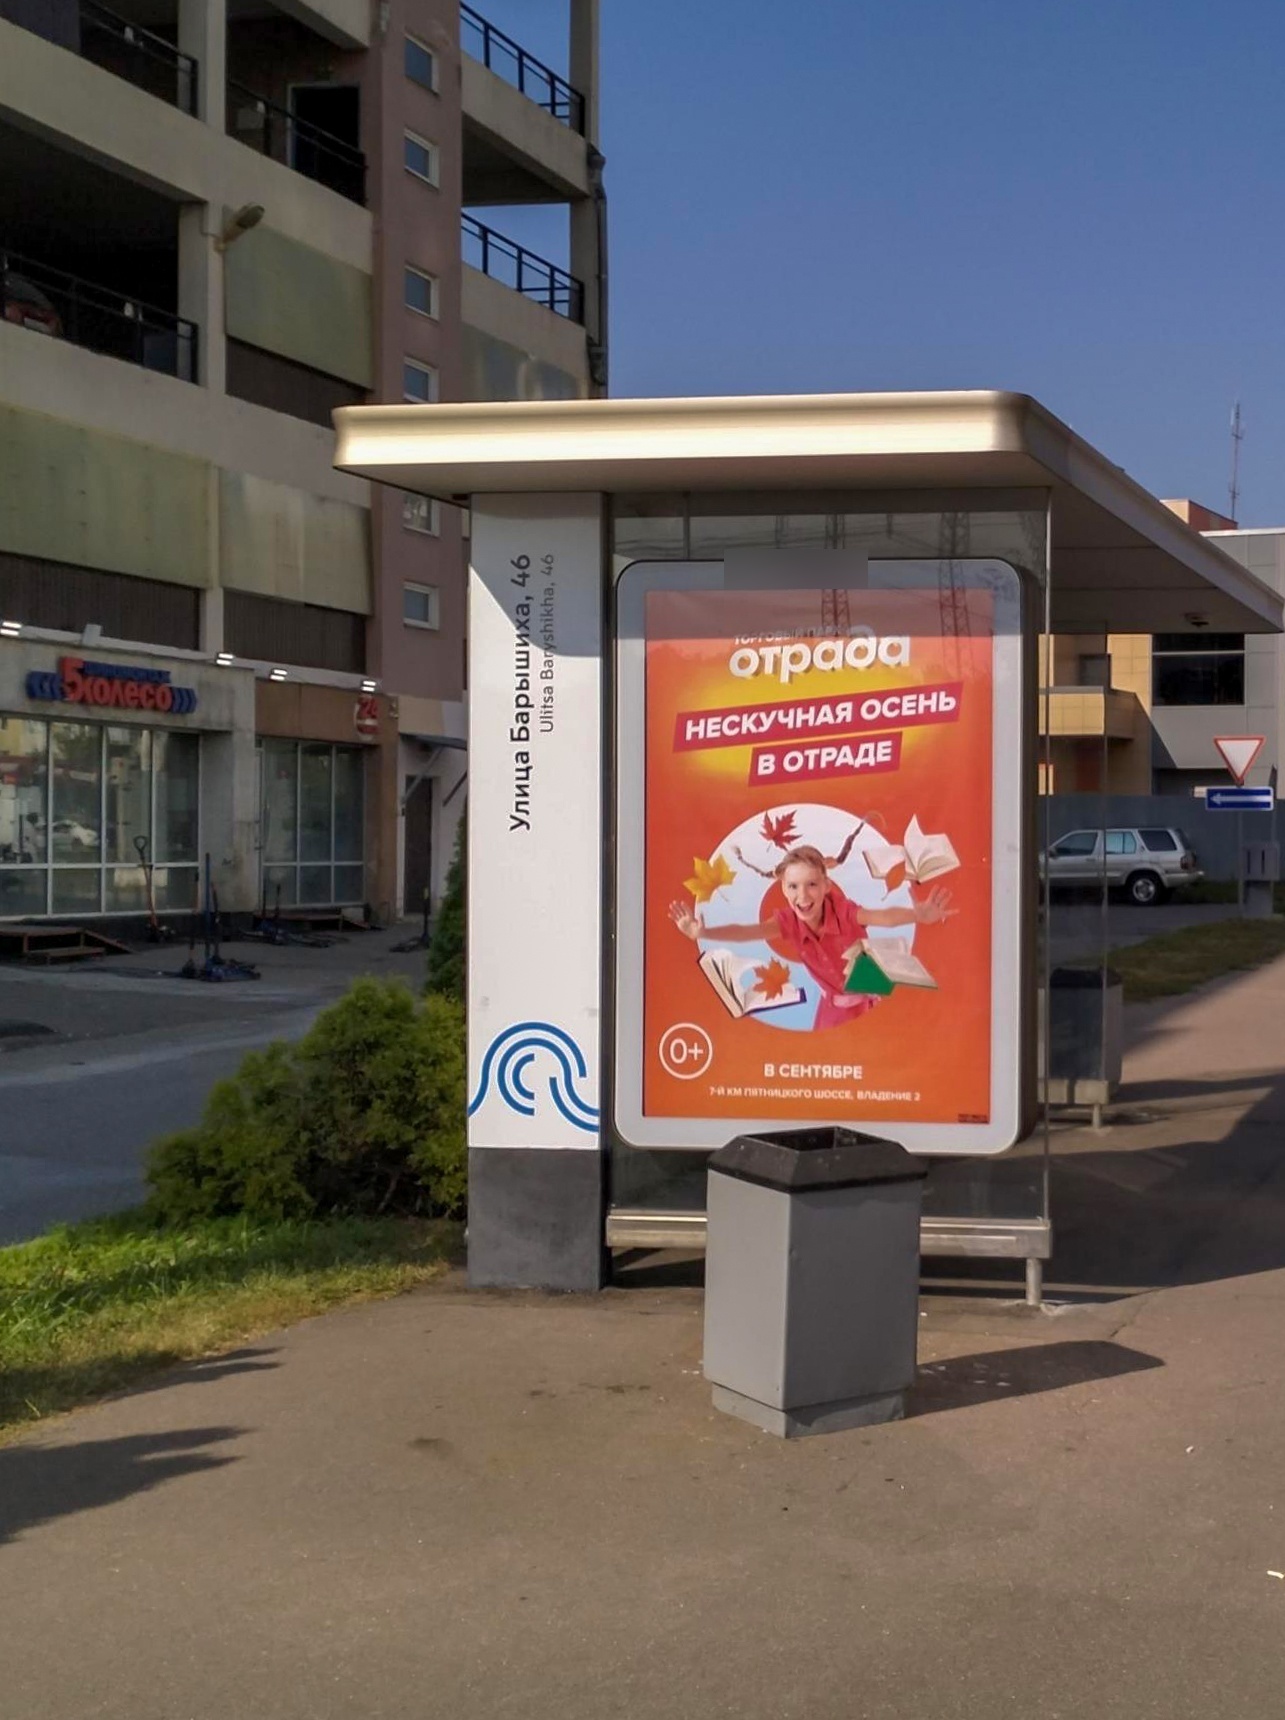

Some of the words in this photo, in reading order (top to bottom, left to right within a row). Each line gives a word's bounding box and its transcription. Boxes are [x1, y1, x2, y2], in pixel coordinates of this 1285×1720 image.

[511, 554, 531, 588] 46
[540, 554, 555, 576] 46
[539, 582, 556, 680] Baryshikha,
[510, 594, 535, 742] Барышиха,
[540, 683, 554, 732] Ulitsa
[685, 702, 853, 741] НЕСКУЧНАЯ
[860, 691, 956, 720] ОСЕНЬ
[757, 754, 775, 775] В
[783, 741, 892, 772] ОТРАДЕ
[509, 751, 533, 831] Улица
[670, 1038, 704, 1064] 0+
[764, 1063, 774, 1078] В
[778, 1063, 863, 1080] СЕНТЯБРЕ
[727, 1087, 742, 1097] КМ
[744, 1086, 812, 1099] ПЯТНИЦКОГО
[857, 1090, 912, 1101] ВЛАДЕНИЕ
[914, 1093, 921, 1102] 2
